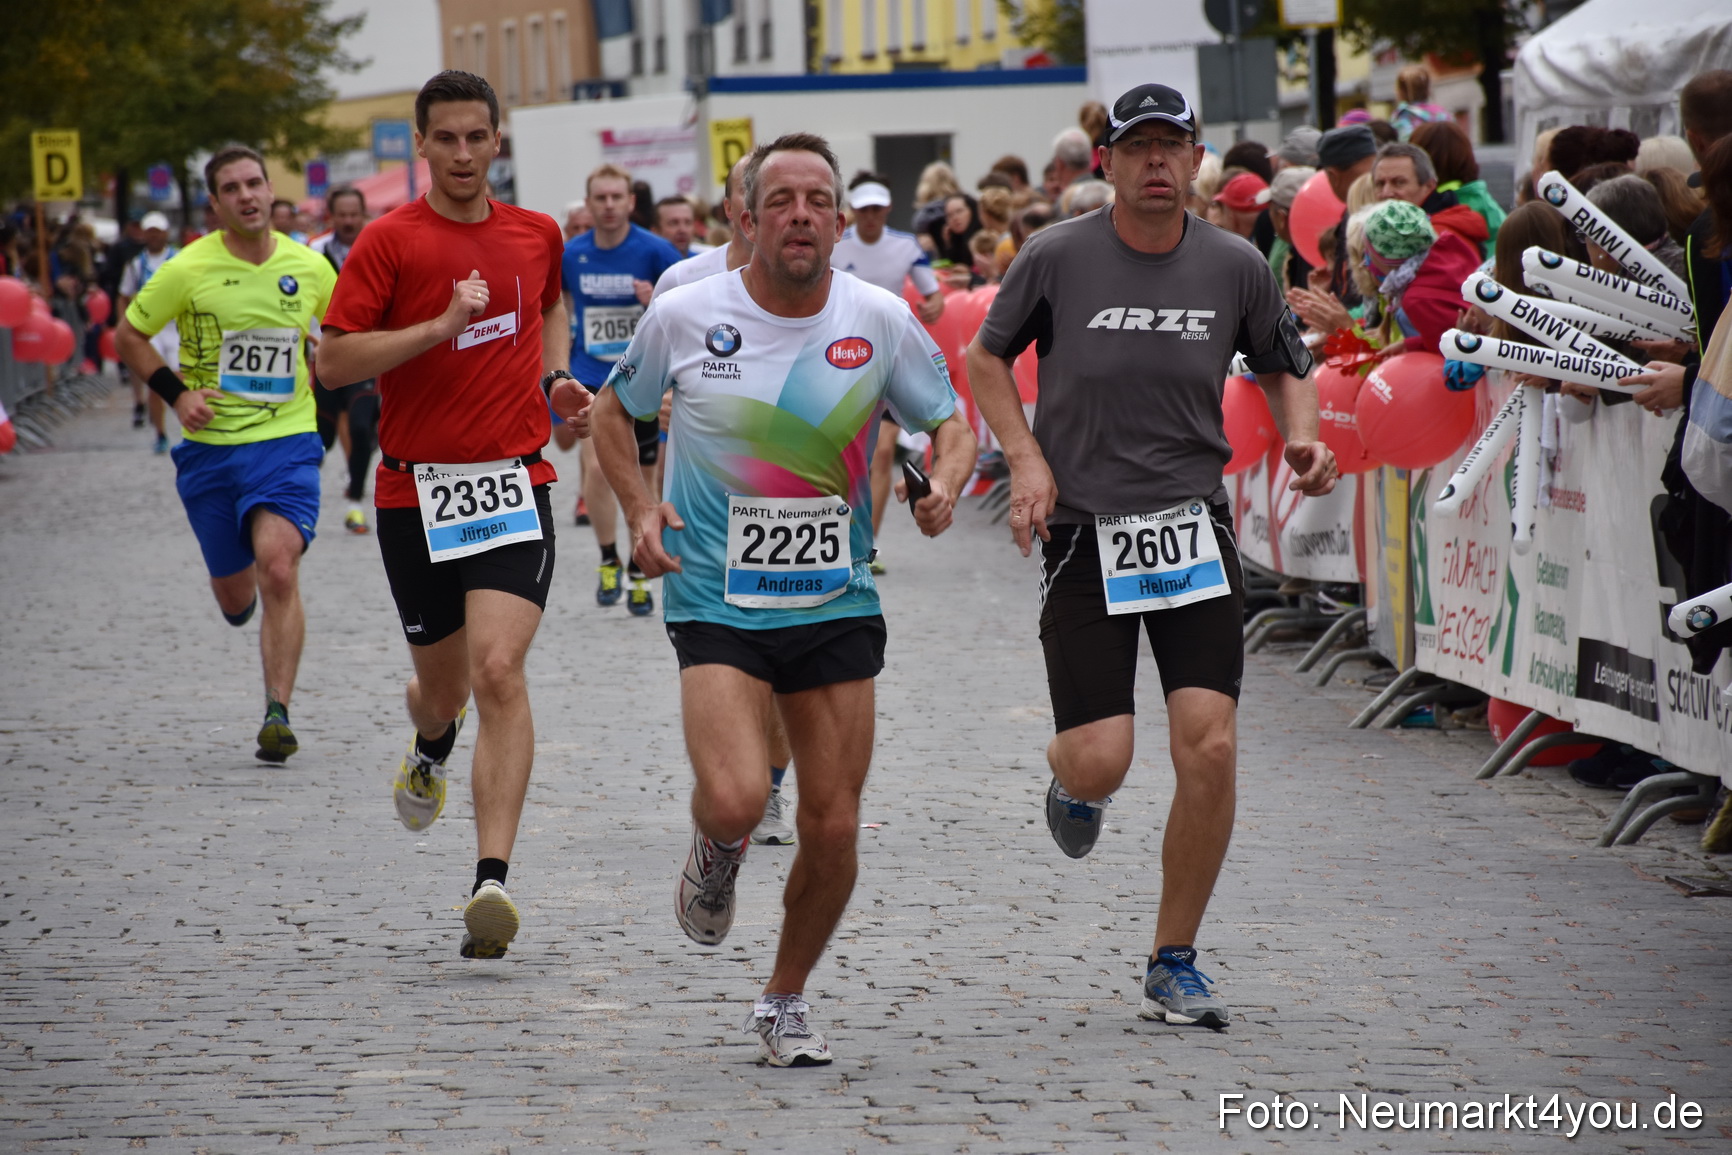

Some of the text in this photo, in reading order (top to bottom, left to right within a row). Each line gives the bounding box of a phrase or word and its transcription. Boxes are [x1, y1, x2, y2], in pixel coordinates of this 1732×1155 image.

[46, 152, 70, 186] D
[1571, 206, 1624, 253] BMW
[1576, 261, 1630, 293] BMW
[474, 322, 501, 339] DEHN
[1086, 307, 1217, 332] ARZT
[1510, 298, 1571, 342] BMW
[1180, 331, 1211, 341] REISEN
[228, 344, 293, 374] 2671
[832, 345, 868, 361] Hervis
[701, 371, 742, 380] Neumarkt
[702, 361, 742, 373] PARTL
[249, 379, 273, 392] Ralf
[431, 472, 524, 523] 2335
[732, 506, 832, 520] PARTL Neumarkt
[1099, 507, 1186, 527] PARTL Neumarkt
[460, 521, 508, 543] Jürgen
[740, 521, 840, 565] 2225
[1112, 521, 1200, 571] 2607
[756, 576, 823, 593] Andreas
[1139, 573, 1193, 595] Helmut
